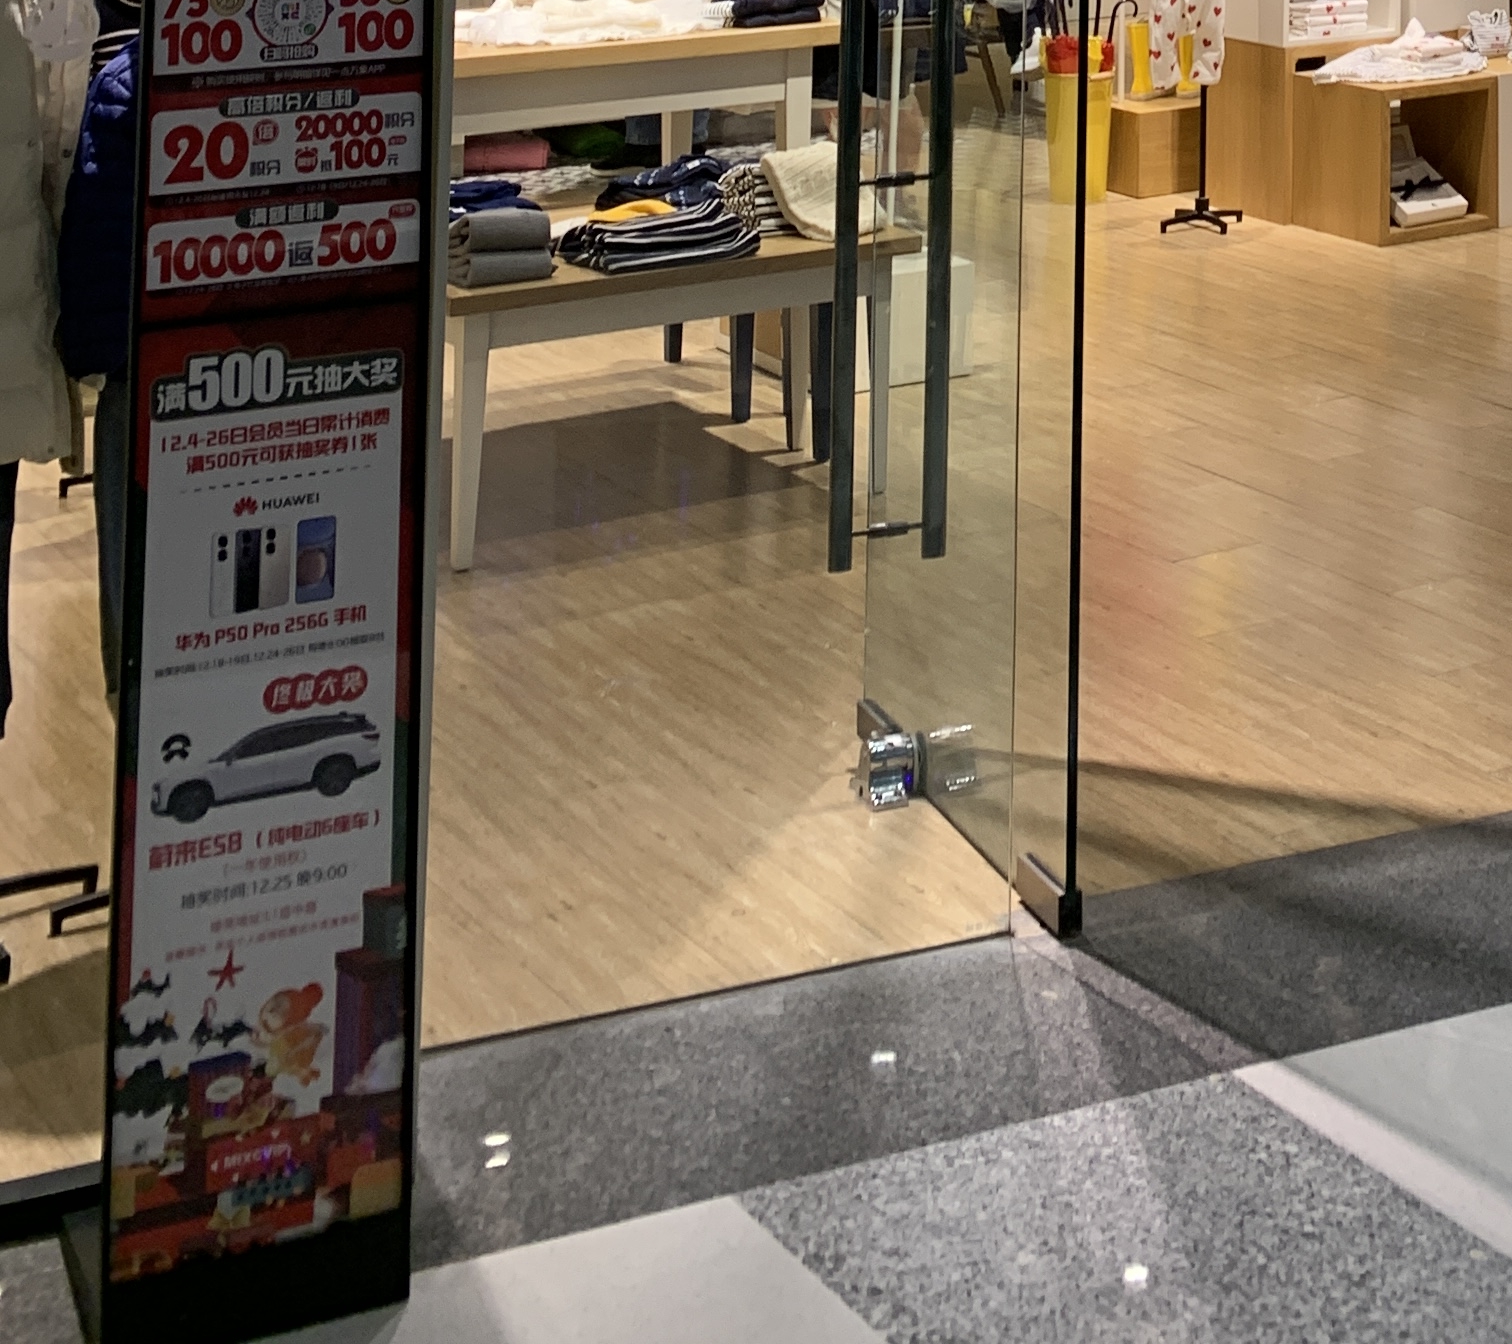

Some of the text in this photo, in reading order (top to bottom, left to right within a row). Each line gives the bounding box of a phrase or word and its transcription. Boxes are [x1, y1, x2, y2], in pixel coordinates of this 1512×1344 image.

[161, 18, 243, 66] 100
[337, 8, 415, 54] 100
[163, 120, 250, 185] 20
[156, 348, 399, 414] 满500元抽大奖
[262, 492, 320, 511] HUAWEI
[175, 605, 368, 652] 华为 P50 Pro 256G 手机
